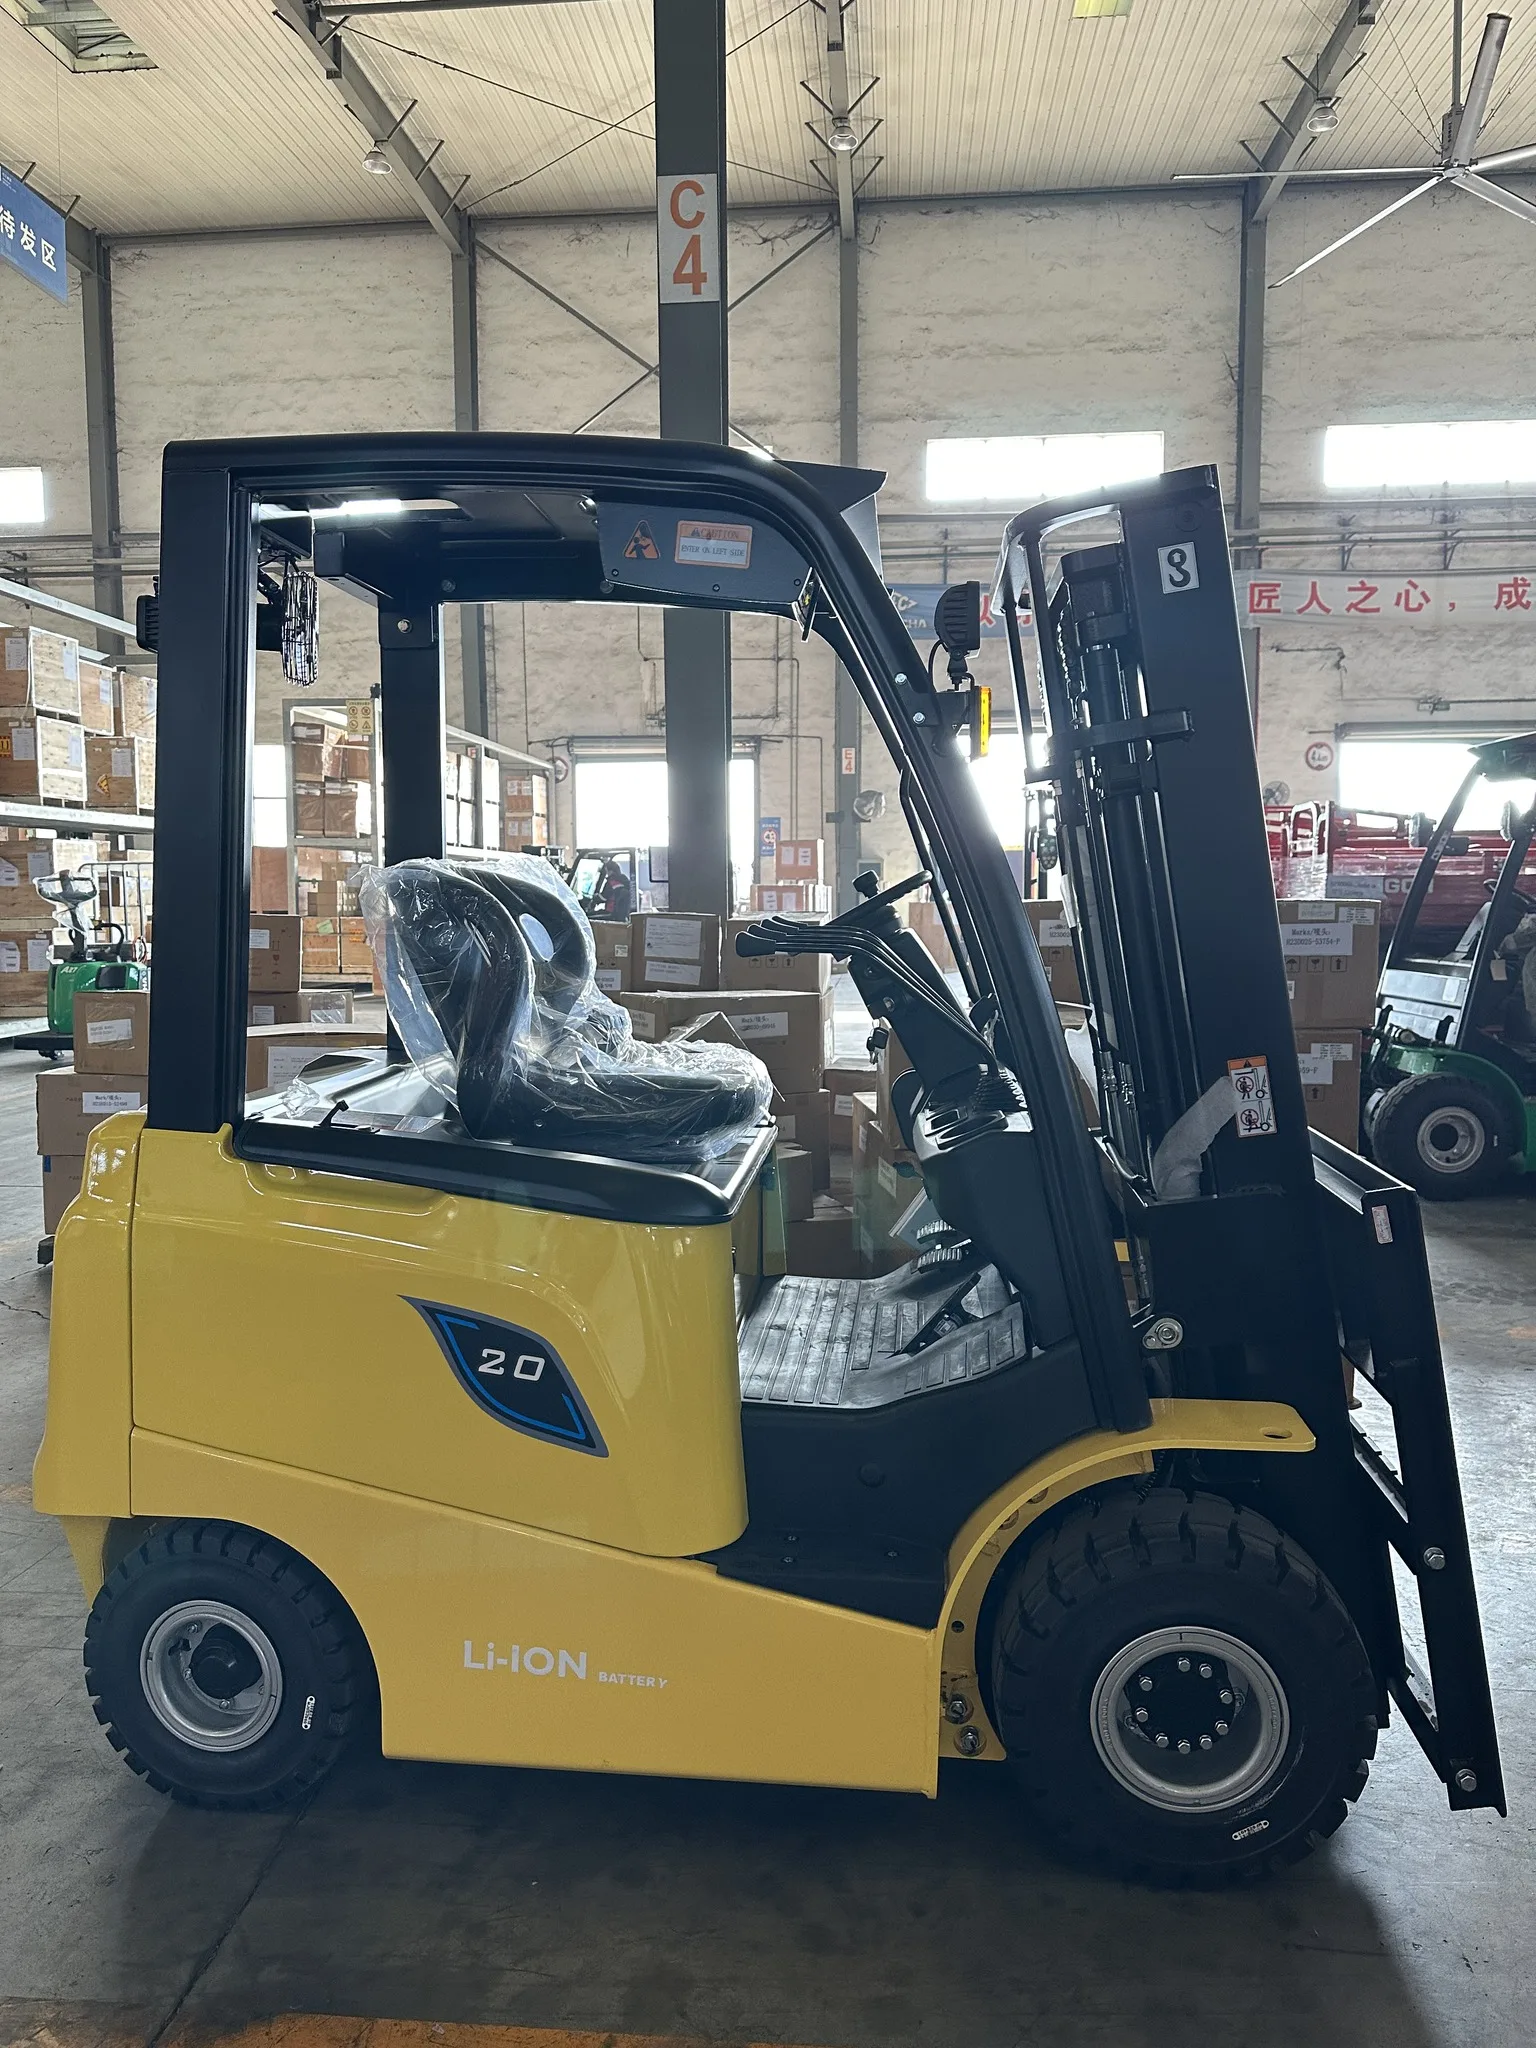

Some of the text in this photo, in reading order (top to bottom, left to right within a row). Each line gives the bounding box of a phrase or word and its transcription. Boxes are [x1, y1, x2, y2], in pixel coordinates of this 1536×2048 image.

[0, 205, 57, 272] 待发区
[670, 180, 708, 295] C4
[700, 527, 739, 539] CAUTION
[681, 544, 700, 553] ENTER
[712, 547, 727, 556] LEFT
[730, 548, 745, 557] SIDE
[844, 749, 854, 773] E4
[478, 1348, 546, 1382] 20
[463, 1639, 668, 1689] Li-ION BATTERY
